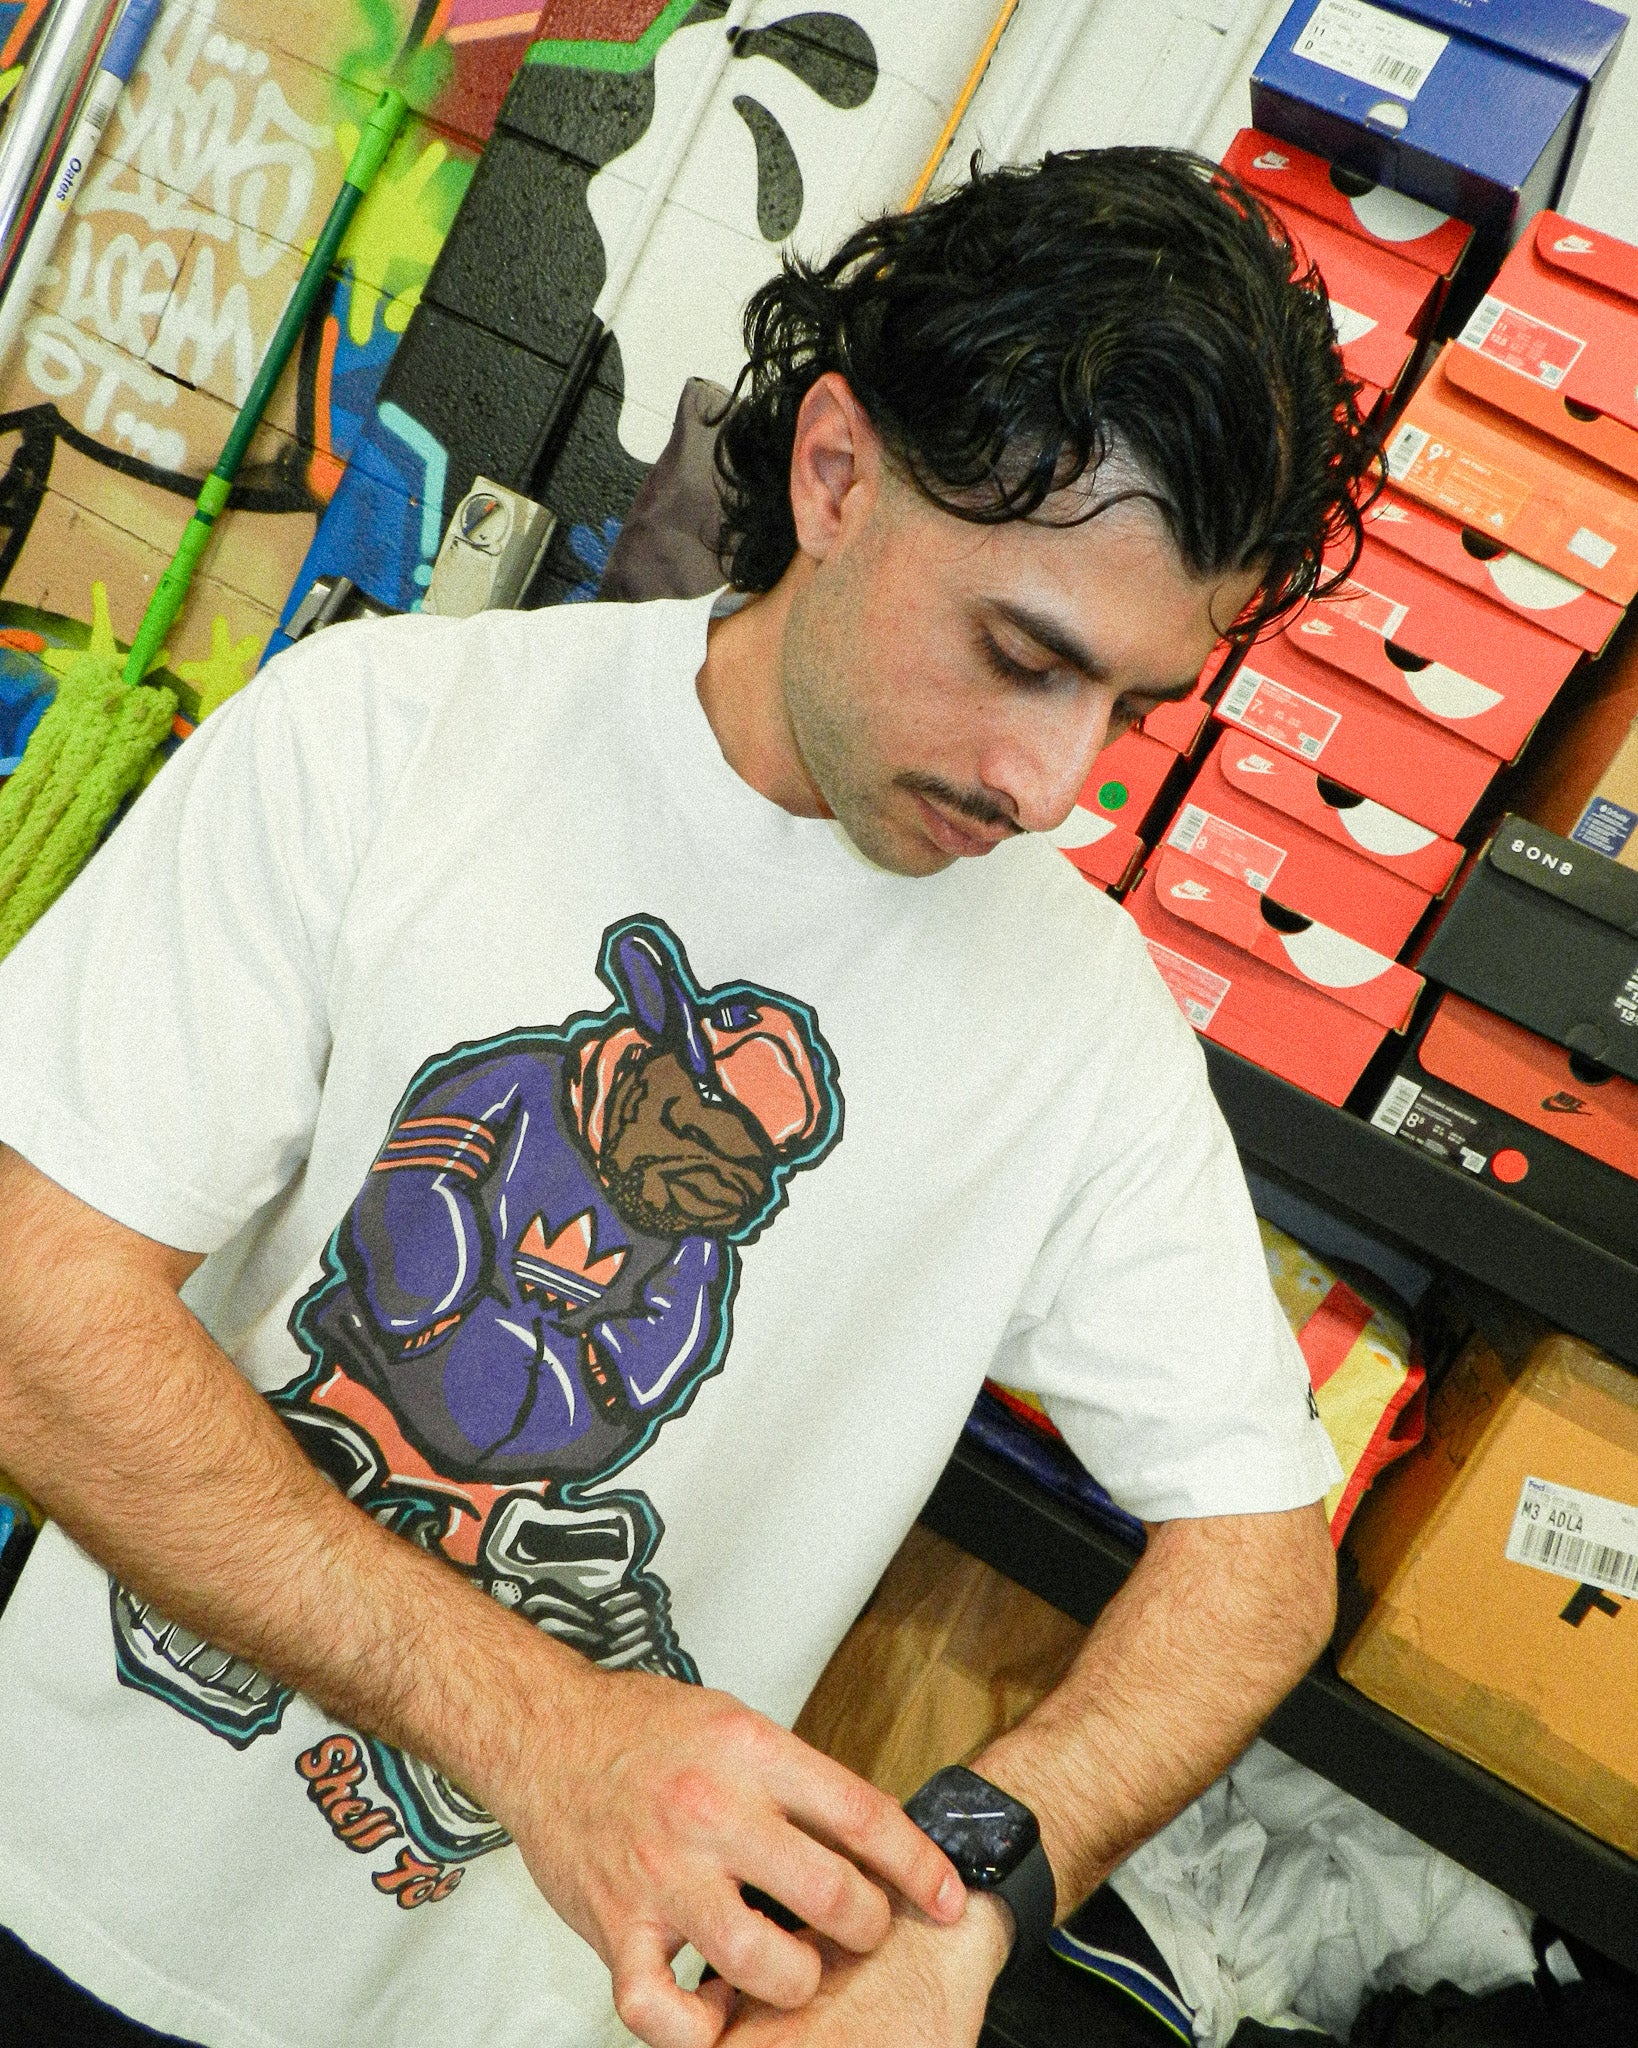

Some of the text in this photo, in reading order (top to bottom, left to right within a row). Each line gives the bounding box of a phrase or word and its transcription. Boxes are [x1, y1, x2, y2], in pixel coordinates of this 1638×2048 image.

[56, 158, 82, 200] Oates
[295, 1734, 465, 1910] Shell Toe
